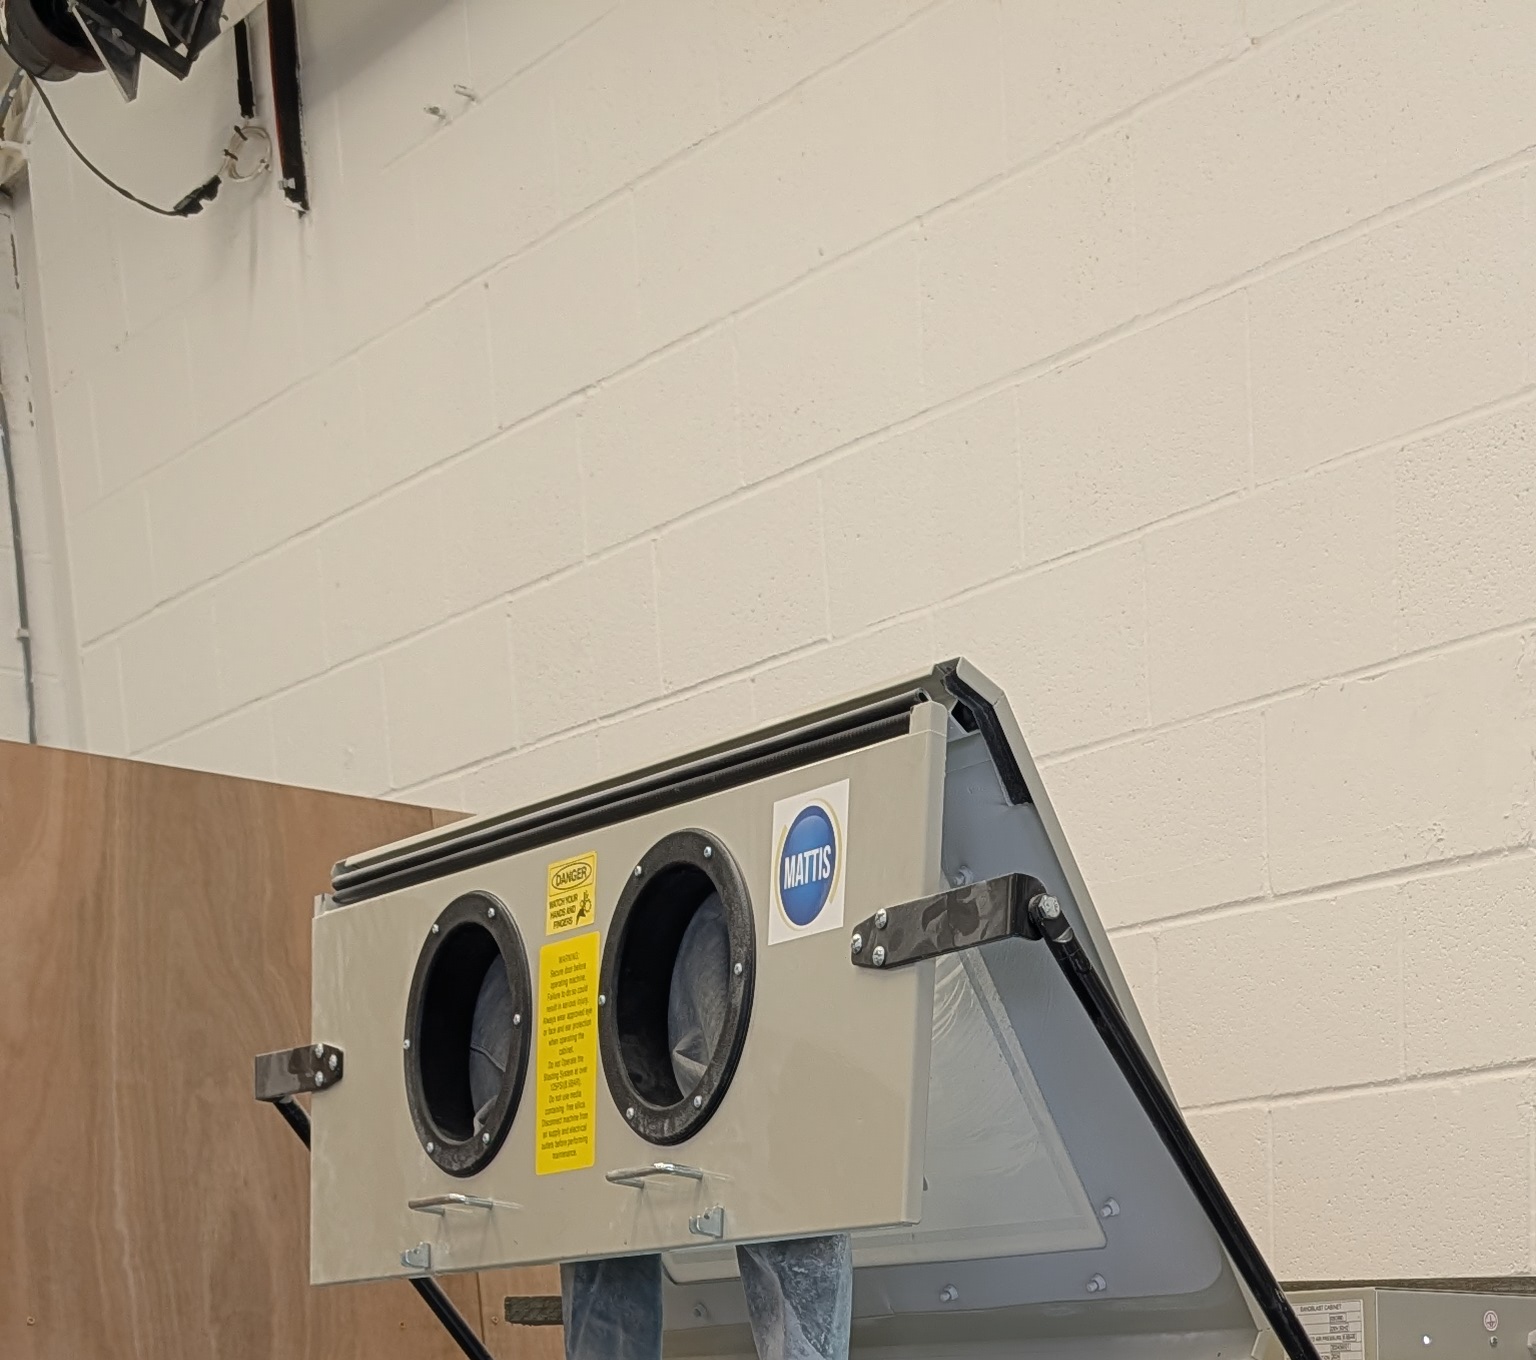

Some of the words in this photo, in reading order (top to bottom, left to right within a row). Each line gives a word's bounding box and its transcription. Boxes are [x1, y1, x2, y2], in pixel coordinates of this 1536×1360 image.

[783, 844, 831, 890] MATTIS
[556, 865, 587, 887] DANGER
[566, 893, 578, 905] YOUR
[550, 908, 566, 920] HANDS
[567, 905, 576, 915] AND
[553, 917, 573, 930] FINGERS
